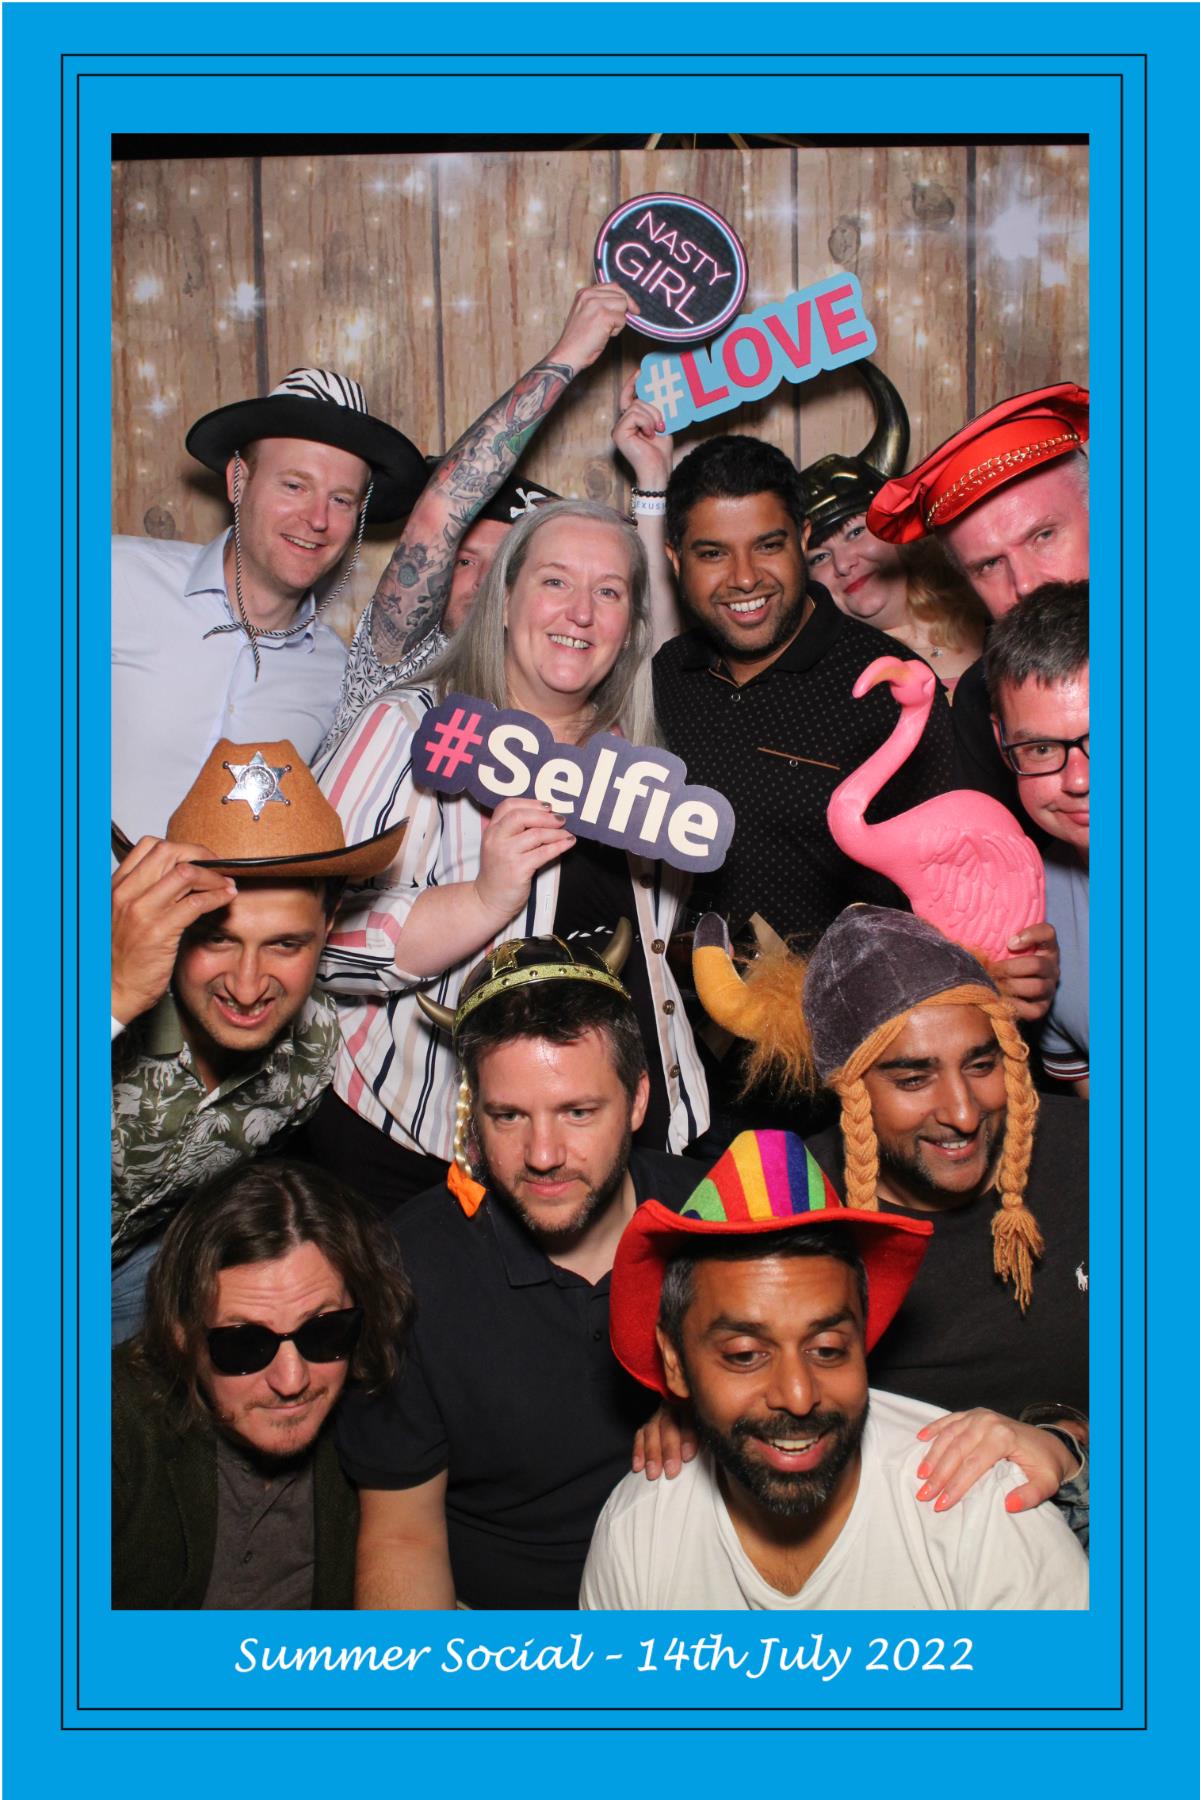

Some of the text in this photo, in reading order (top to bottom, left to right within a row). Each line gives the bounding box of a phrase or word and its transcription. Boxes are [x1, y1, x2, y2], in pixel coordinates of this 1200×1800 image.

[614, 241, 697, 325] GIRL
[635, 210, 732, 286] NASTY
[643, 282, 869, 420] #LOVE
[424, 707, 720, 858] #Selfie
